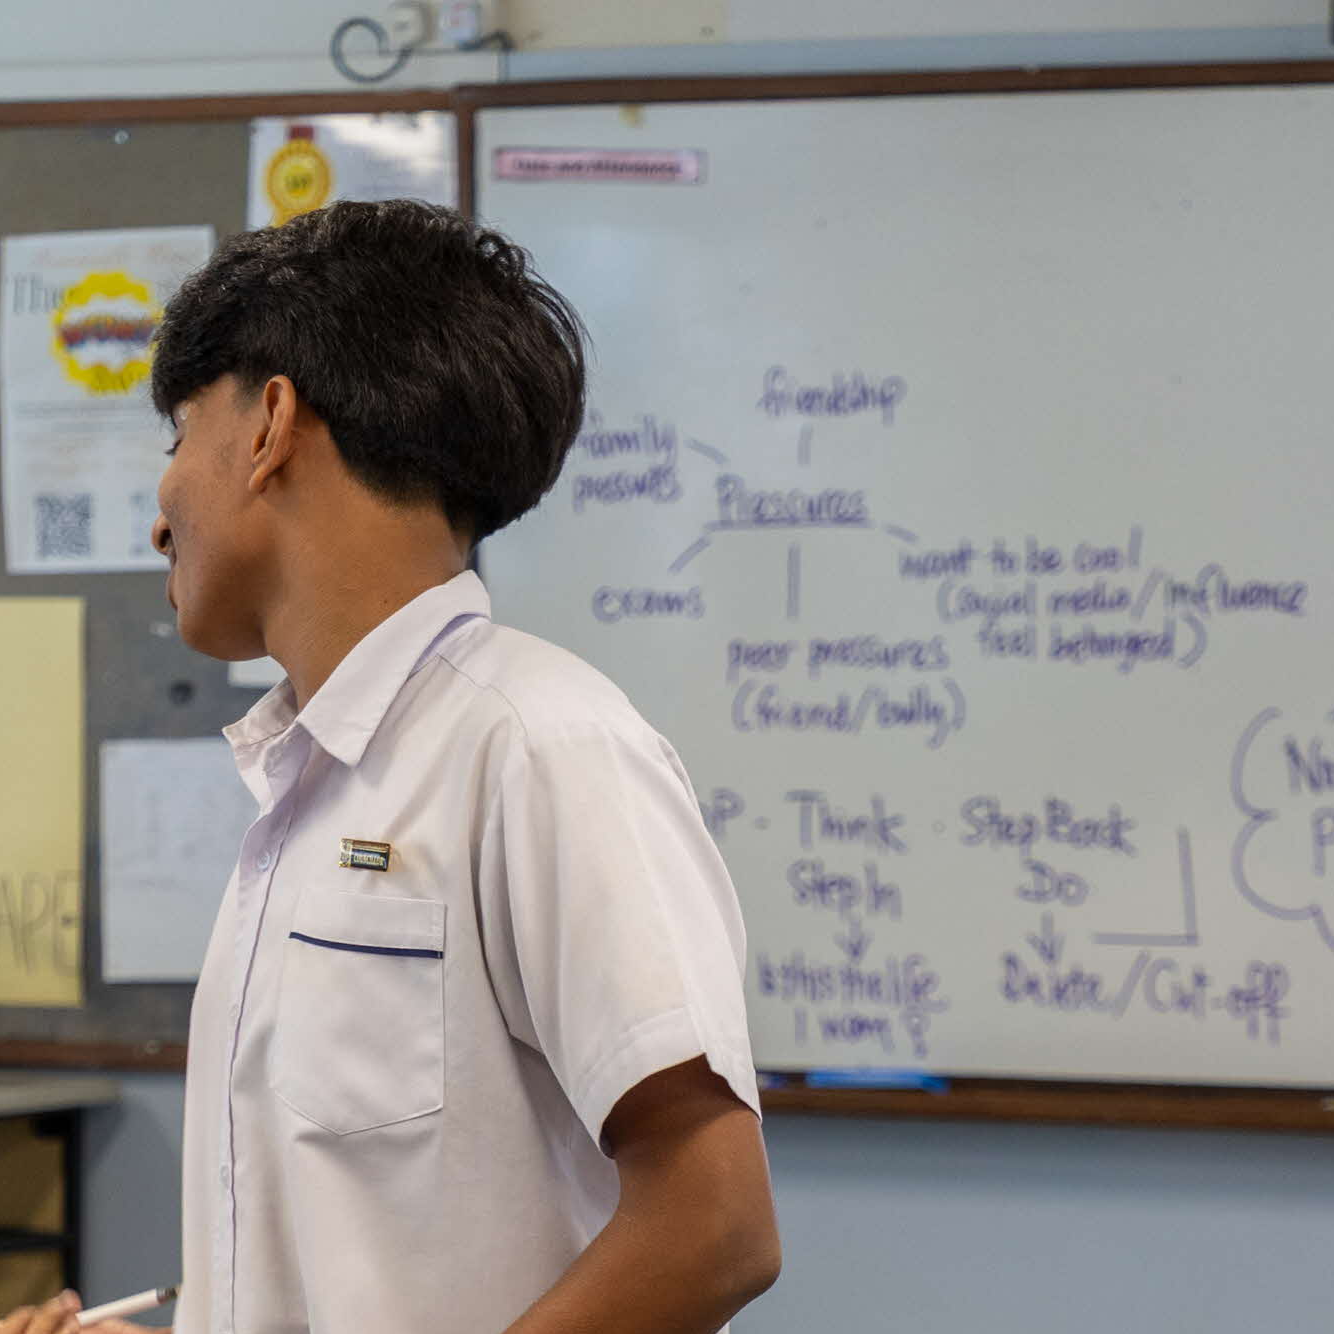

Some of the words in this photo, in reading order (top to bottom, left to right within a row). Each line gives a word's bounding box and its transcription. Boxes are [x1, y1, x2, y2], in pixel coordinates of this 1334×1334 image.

[756, 367, 906, 426] friendship
[715, 475, 867, 523] Pressures
[988, 539, 1017, 573] to
[1026, 534, 1062, 573] be
[1072, 524, 1143, 574] cool
[592, 586, 704, 624] exams
[726, 638, 795, 684] peer
[808, 635, 947, 680] pressures
[979, 619, 1038, 658] feel
[785, 789, 908, 854] Think
[1048, 796, 1136, 856] Back
[1017, 858, 1089, 905] Do
